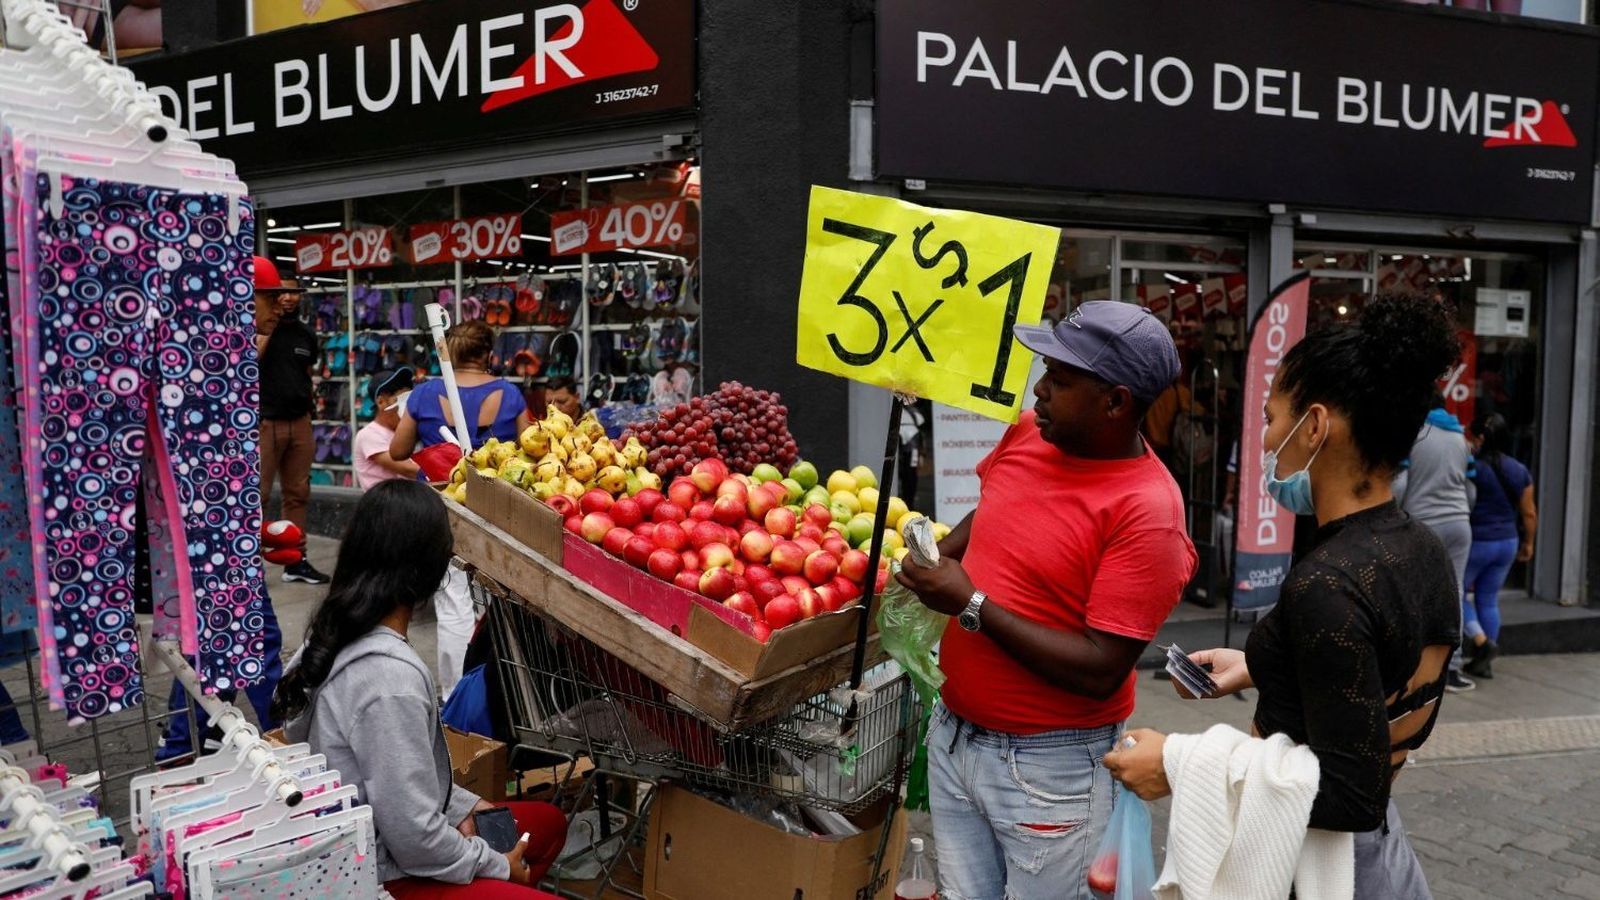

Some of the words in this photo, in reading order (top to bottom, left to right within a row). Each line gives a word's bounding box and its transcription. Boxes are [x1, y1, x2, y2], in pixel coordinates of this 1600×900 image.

[274, 3, 585, 128] BLUMER
[917, 31, 1194, 106] PALACIO
[1213, 63, 1319, 120] DEL
[1337, 76, 1541, 142] BLUMER
[595, 93, 602, 104] J
[603, 84, 659, 103] 31623742-7
[451, 216, 520, 258] 30%
[599, 201, 683, 247] 40%
[331, 228, 391, 267] 20%
[822, 217, 897, 367] 3
